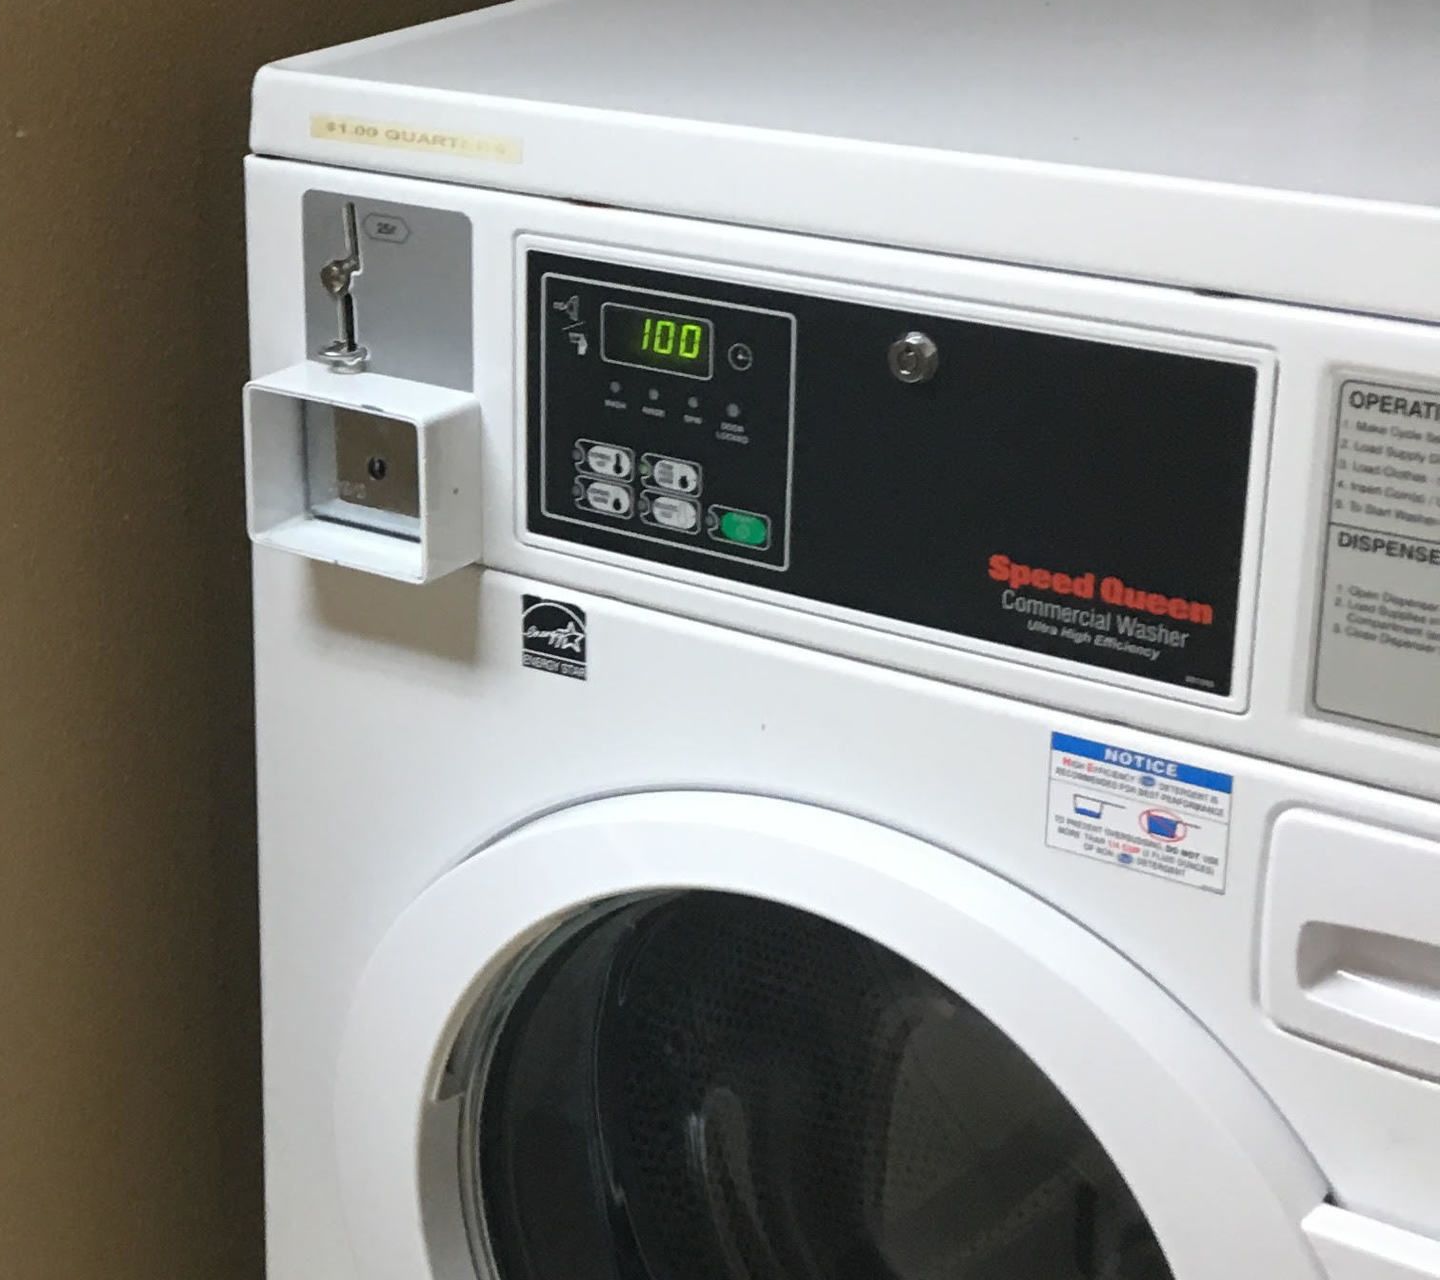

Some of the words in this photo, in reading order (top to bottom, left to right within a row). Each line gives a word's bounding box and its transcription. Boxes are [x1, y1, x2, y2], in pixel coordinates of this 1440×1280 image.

[641, 317, 703, 360] 100
[988, 554, 1096, 600] Speed
[1099, 575, 1214, 625] Queen
[1001, 588, 1112, 632] Commercial
[1116, 613, 1191, 648] Washer
[1027, 619, 1059, 637] Ultra
[1060, 626, 1093, 645] High
[1093, 634, 1162, 662] Efficiency
[1104, 748, 1180, 777] NOTICE
